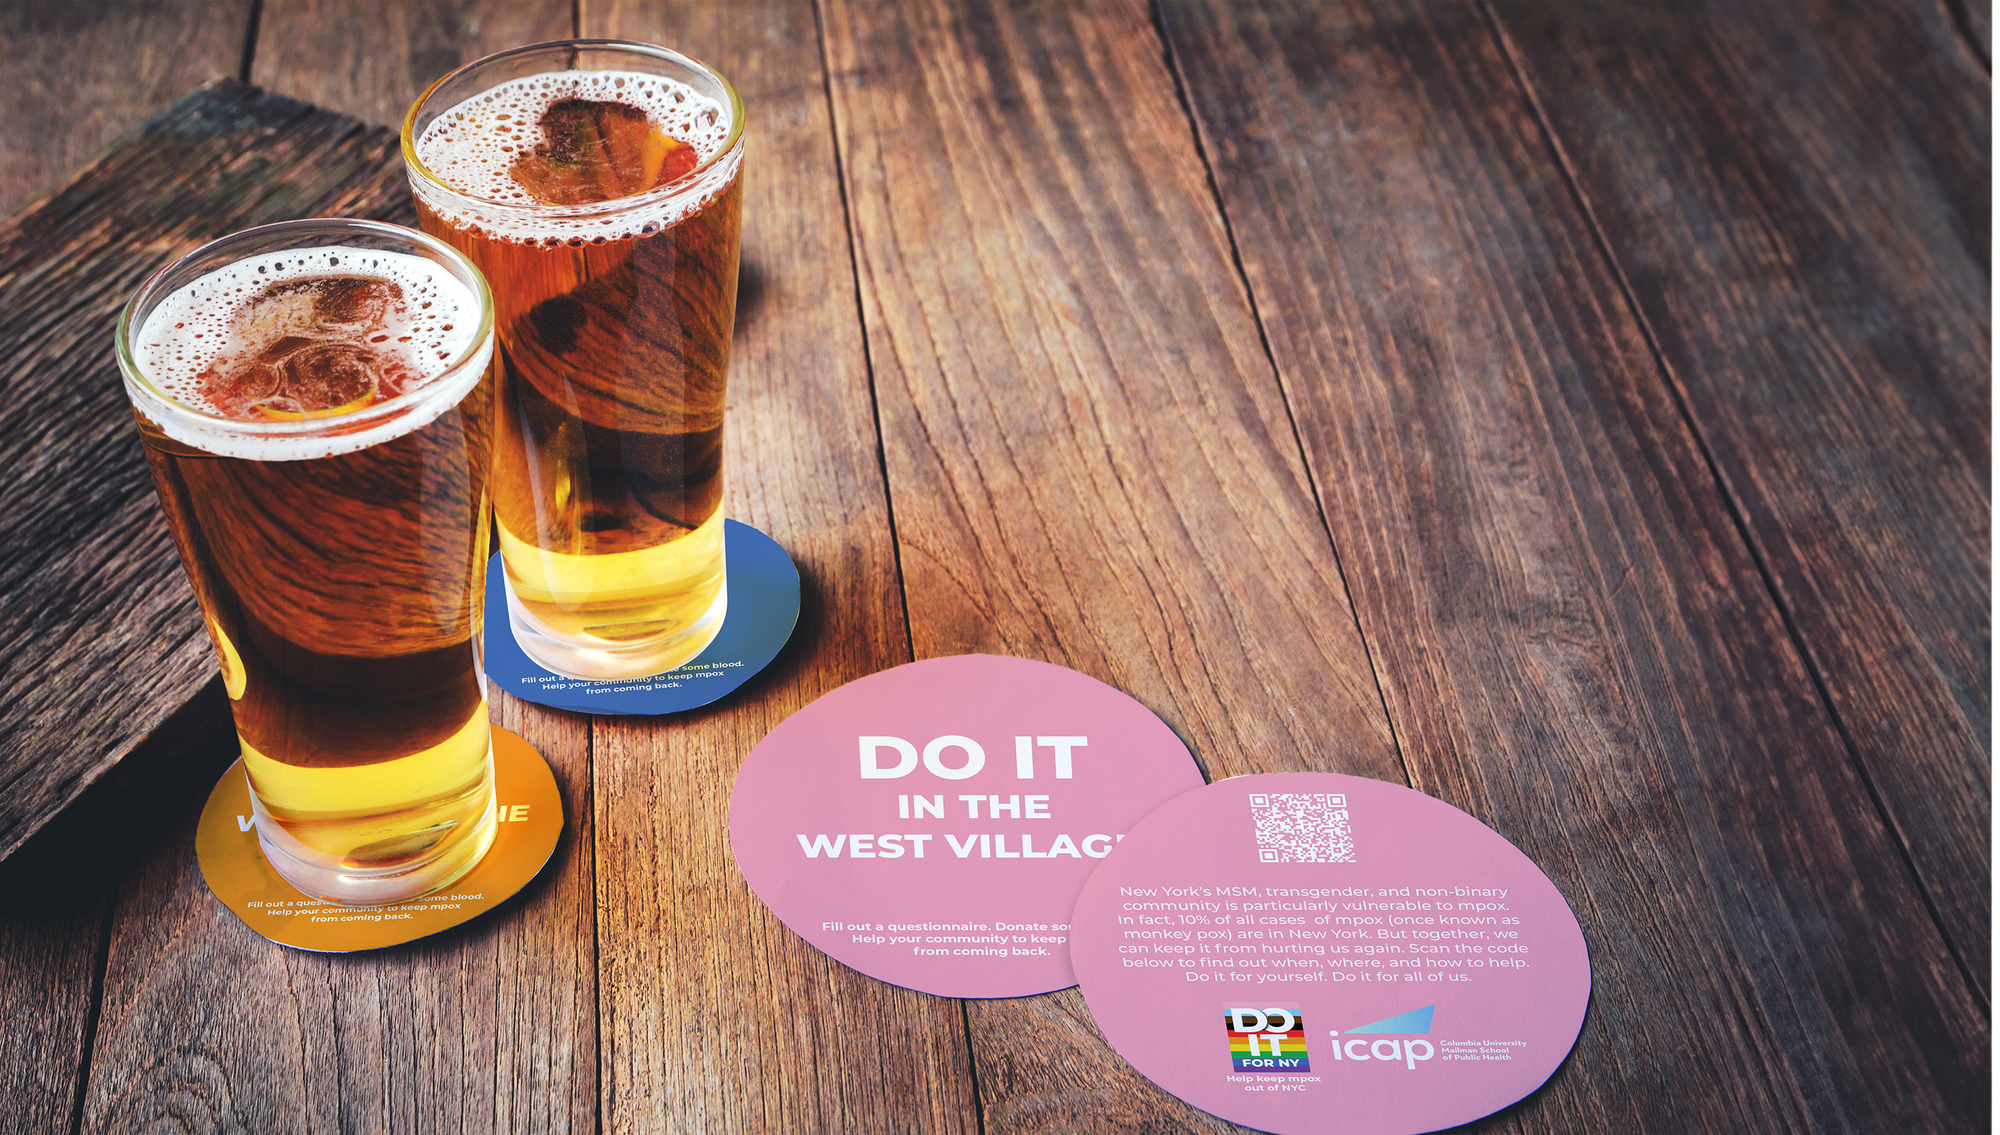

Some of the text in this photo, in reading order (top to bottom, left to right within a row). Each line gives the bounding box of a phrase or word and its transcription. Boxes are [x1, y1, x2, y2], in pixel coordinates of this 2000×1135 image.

[538, 675, 557, 683] out
[681, 664, 710, 672] some
[712, 660, 744, 669] blood.
[568, 681, 592, 690] your
[667, 673, 693, 681] keep
[695, 671, 725, 679] mpox
[585, 681, 683, 695] from coming back.
[858, 734, 1089, 781] DO IT
[898, 794, 1052, 819] IN THE
[795, 833, 1126, 859] WEST VILLAG
[1119, 886, 1508, 899] New York’s MSM, transgender, and non-binary
[247, 901, 263, 909] Fill
[265, 900, 284, 908] out
[450, 893, 485, 901] blood.
[1122, 900, 1510, 913] community is particularly vulnerable to mpox.
[267, 909, 293, 917] Help
[294, 909, 320, 917] your
[321, 905, 385, 914] community
[400, 904, 428, 912] keep
[430, 903, 461, 911] mpox
[311, 912, 414, 923] from coming back.
[1117, 914, 1520, 928] In fact, 10% of all cases of mpox (once known as
[822, 921, 844, 931] Fill
[846, 922, 872, 931] out
[875, 923, 884, 932] a
[887, 921, 992, 933] questionnaire.
[995, 921, 1049, 932] Donate
[852, 933, 1067, 946] Help your community to keep
[1123, 928, 1519, 942] monkey pox) are in New York. But together, we
[913, 945, 1051, 958] from coming back.
[1118, 942, 1529, 956] can keep it from hurting us again. Scan the code
[1122, 956, 1530, 970] below to find out when, where, and how to help.
[1185, 971, 1472, 984] Do it for yourself. Do it for all of us.
[1230, 1007, 1296, 1033] DO
[1247, 1033, 1288, 1057] IT
[1329, 1030, 1435, 1070] icap
[1439, 1039, 1527, 1048] Columbia University
[1441, 1046, 1510, 1054] Mailman School
[1242, 1058, 1300, 1068] FOR NY
[1442, 1053, 1512, 1061] of Public Health
[1226, 1074, 1322, 1084] Help keep mpox
[1244, 1083, 1307, 1092] out of NYC
